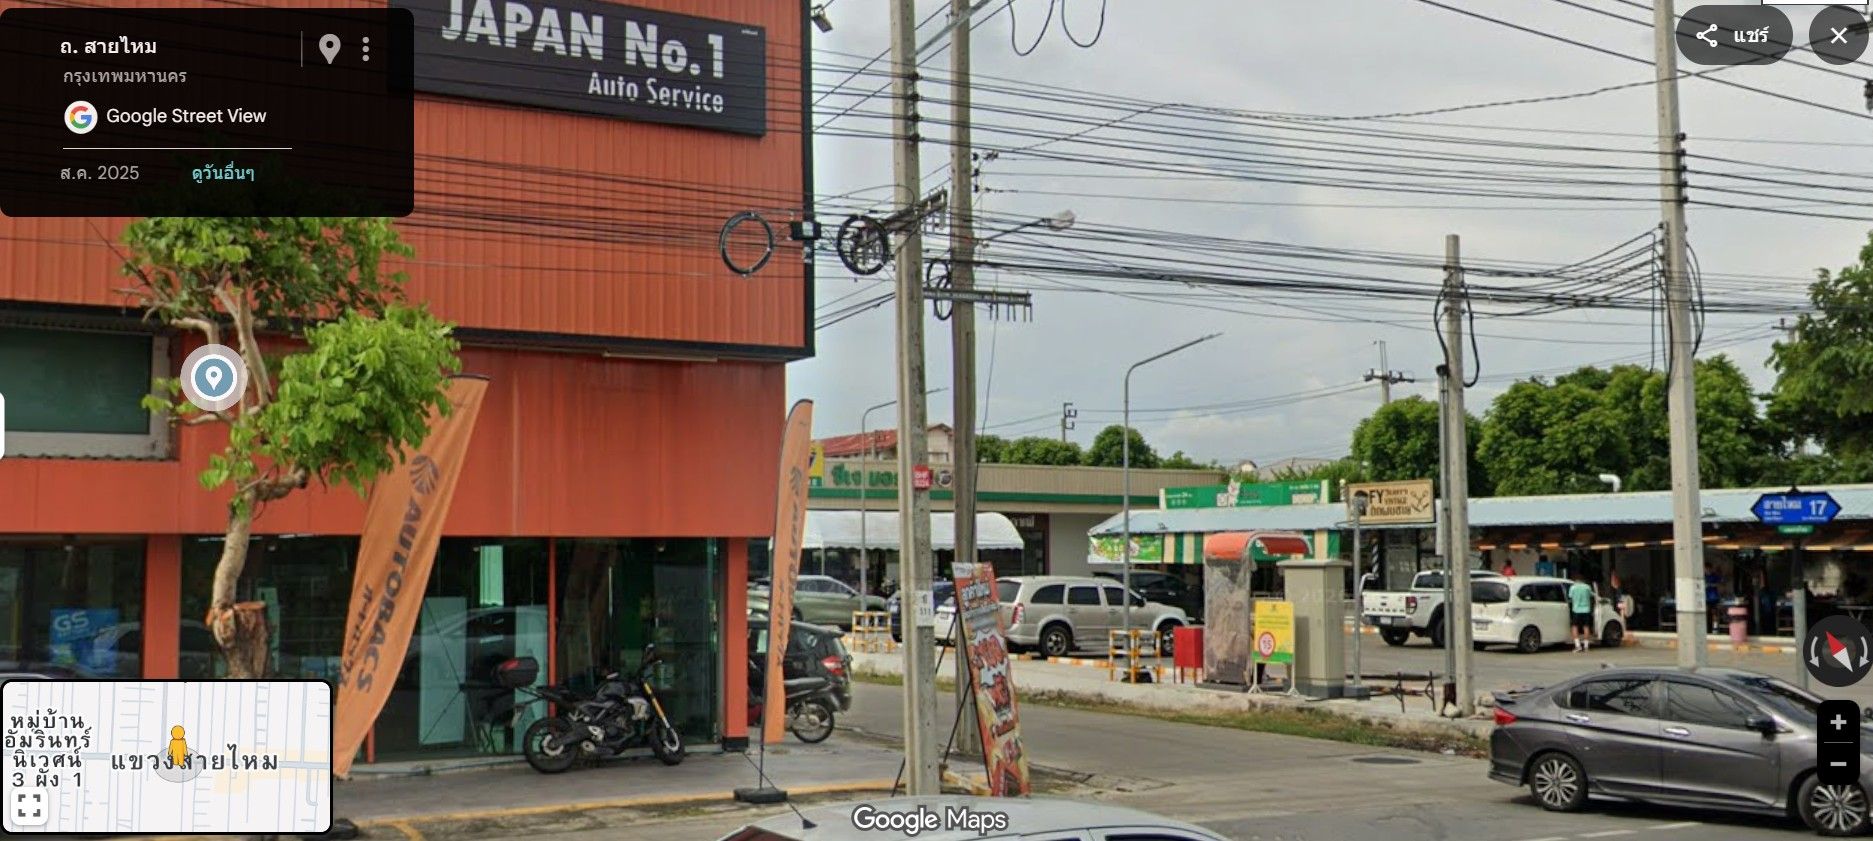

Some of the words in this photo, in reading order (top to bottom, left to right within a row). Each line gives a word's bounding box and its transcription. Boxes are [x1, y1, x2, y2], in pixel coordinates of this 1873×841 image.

[441, 0, 604, 60] JAPAN
[625, 20, 724, 79] No.1
[588, 72, 639, 101] Auto
[647, 78, 724, 113] Service
[1809, 500, 1828, 515] 17
[356, 496, 423, 694] AUTOBACS
[54, 611, 90, 631] GS
